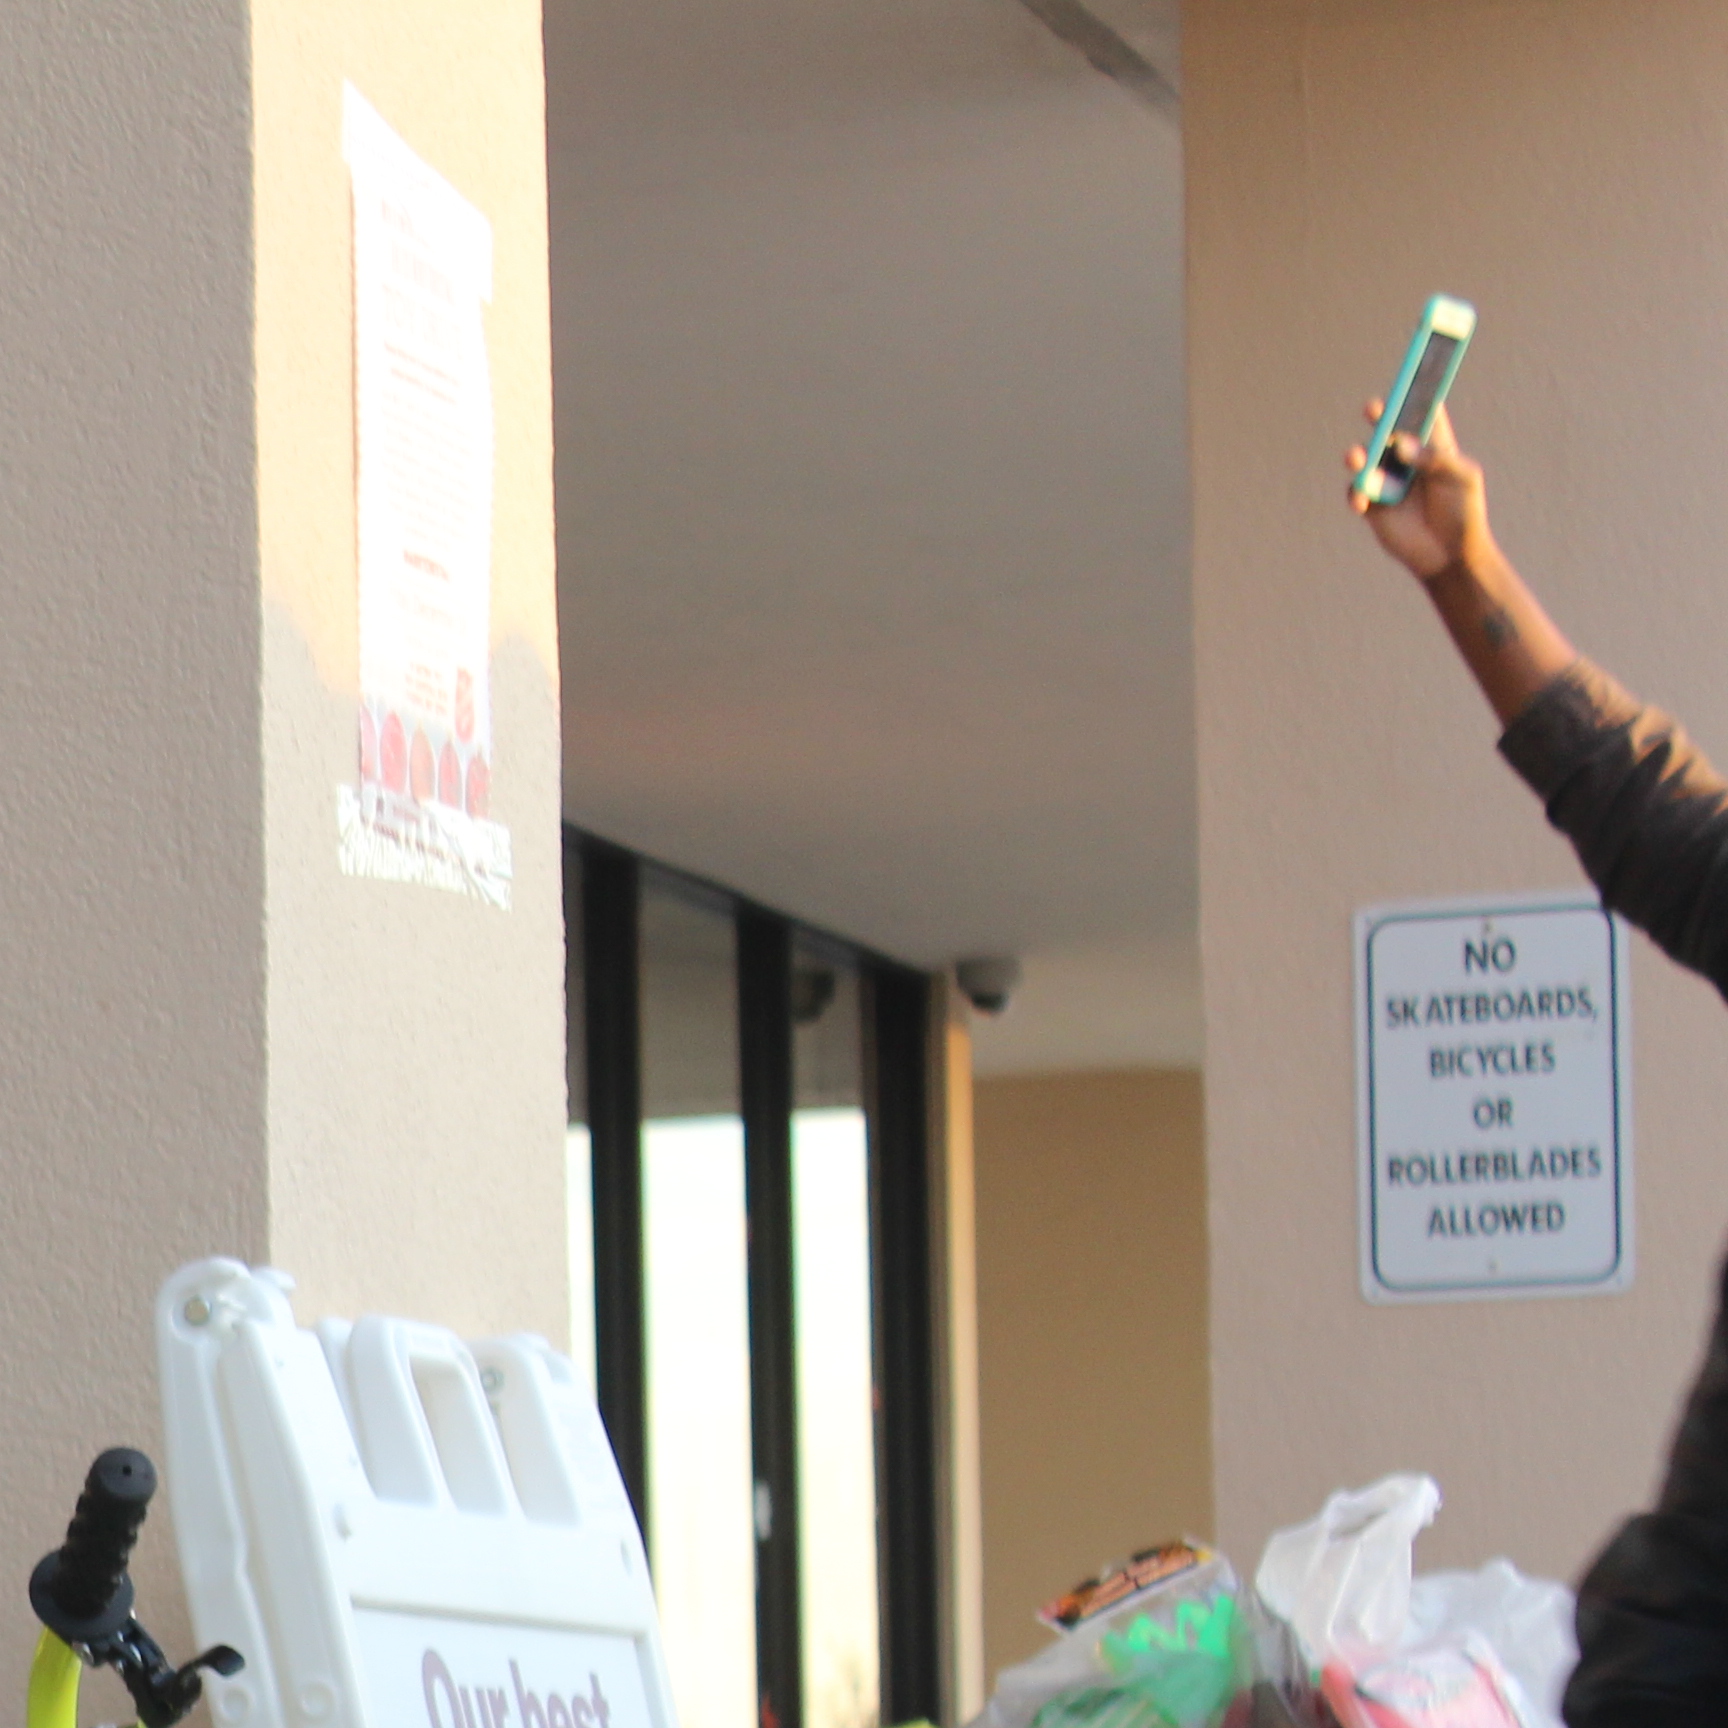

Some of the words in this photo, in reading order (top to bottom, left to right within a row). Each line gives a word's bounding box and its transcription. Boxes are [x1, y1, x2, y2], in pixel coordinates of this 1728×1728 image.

[1464, 936, 1517, 974] NO
[1386, 986, 1598, 1030] SKATEBOARDS,
[1429, 1041, 1556, 1079] BICYCLES
[1472, 1098, 1513, 1129] OR
[1388, 1147, 1602, 1187] ROLLERBLADES
[1427, 1203, 1565, 1238] ALLOWED
